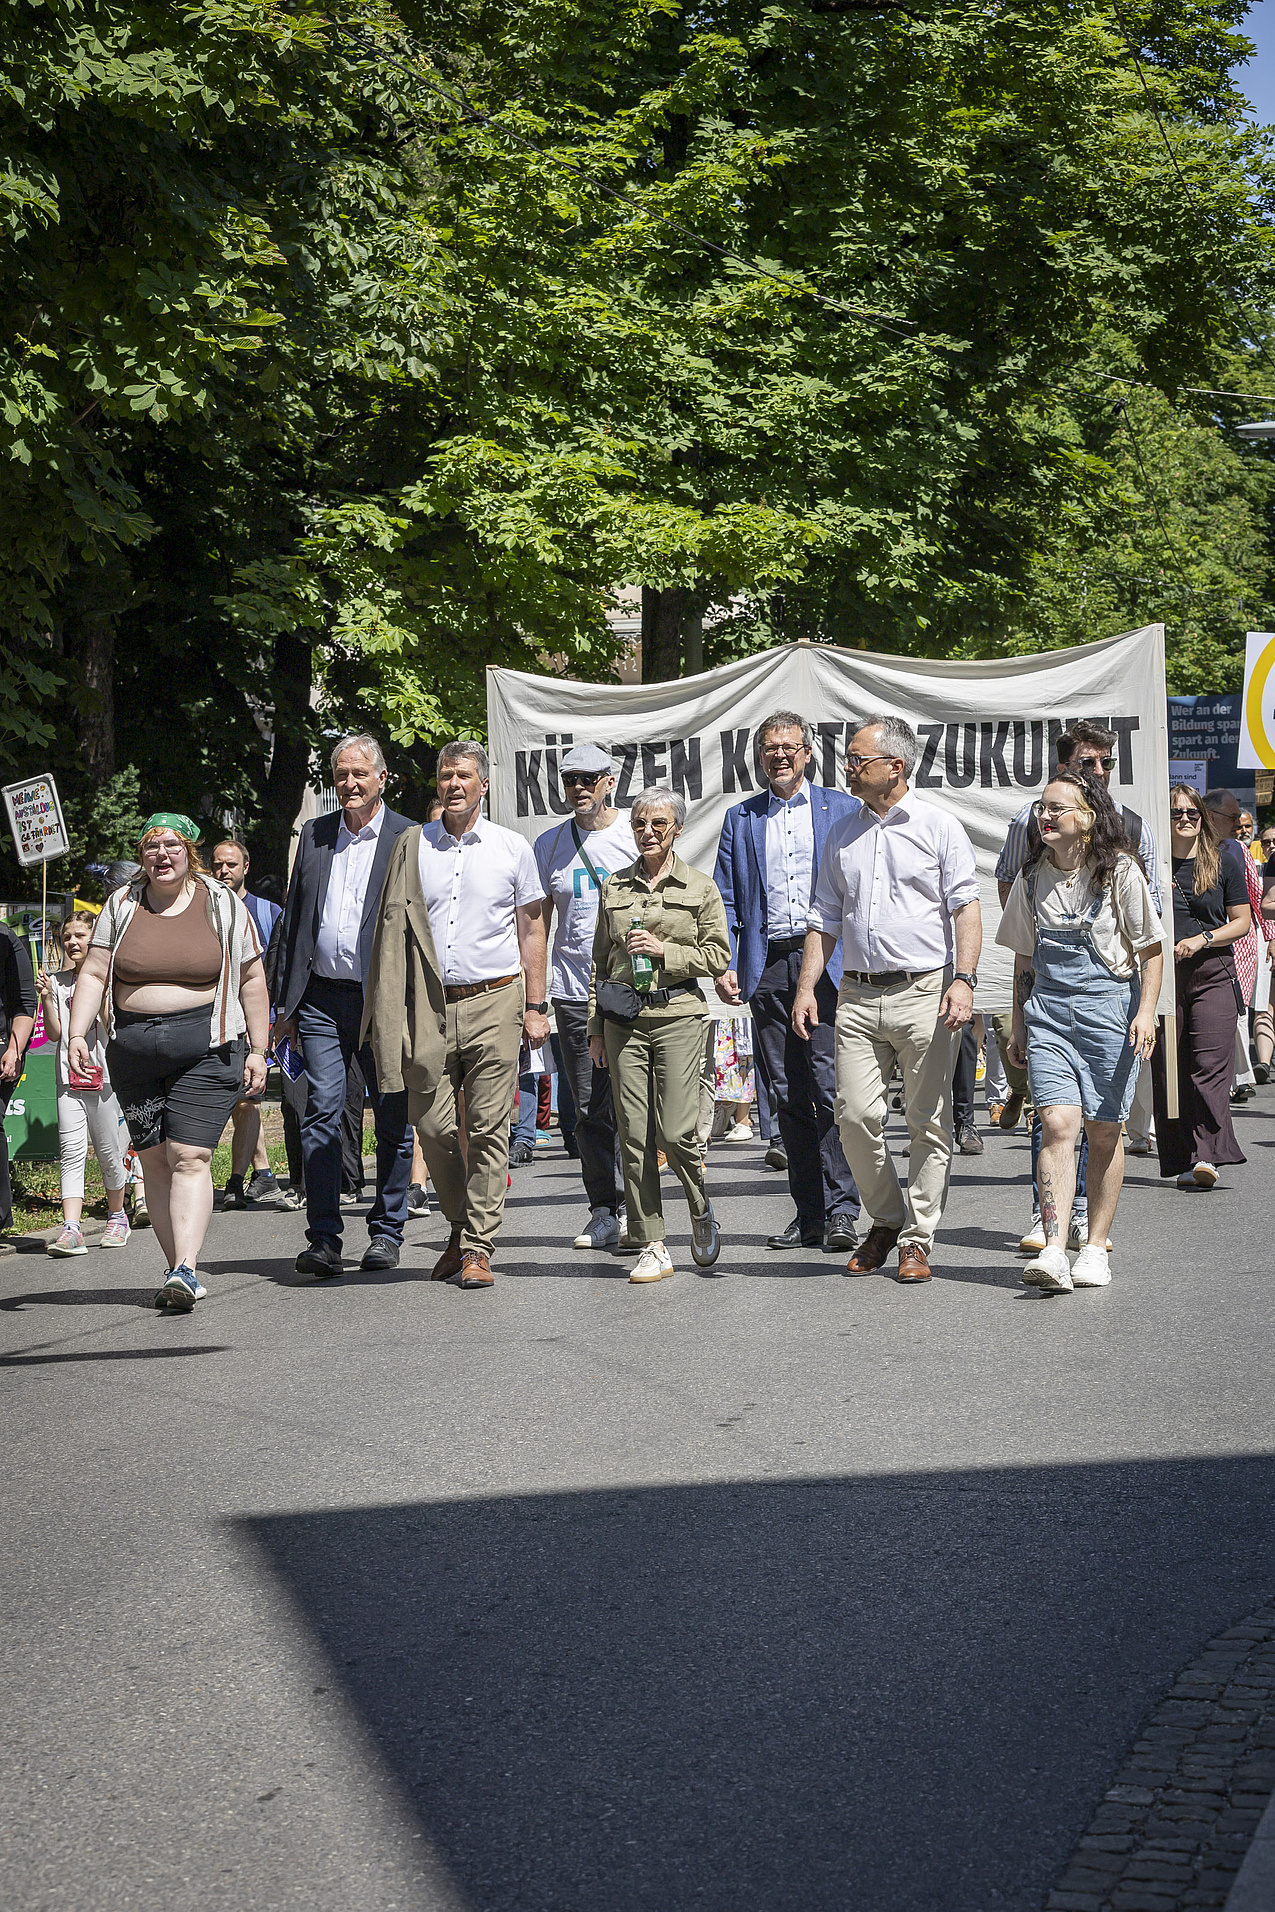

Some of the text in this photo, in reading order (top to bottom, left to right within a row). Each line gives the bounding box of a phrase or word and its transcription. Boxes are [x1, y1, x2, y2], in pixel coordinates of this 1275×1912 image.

[1171, 703, 1232, 716] Wer an der
[1171, 719, 1215, 732] Bildung
[1172, 735, 1202, 748] spart
[1204, 735, 1218, 744] an
[1172, 747, 1220, 760] Zukunft.
[515, 733, 702, 817] KÜZEN
[915, 716, 1139, 789] ZUKUNT
[12, 788, 40, 806] MEINE
[19, 820, 32, 832] IST
[21, 823, 60, 842] GEFÄHRDET
